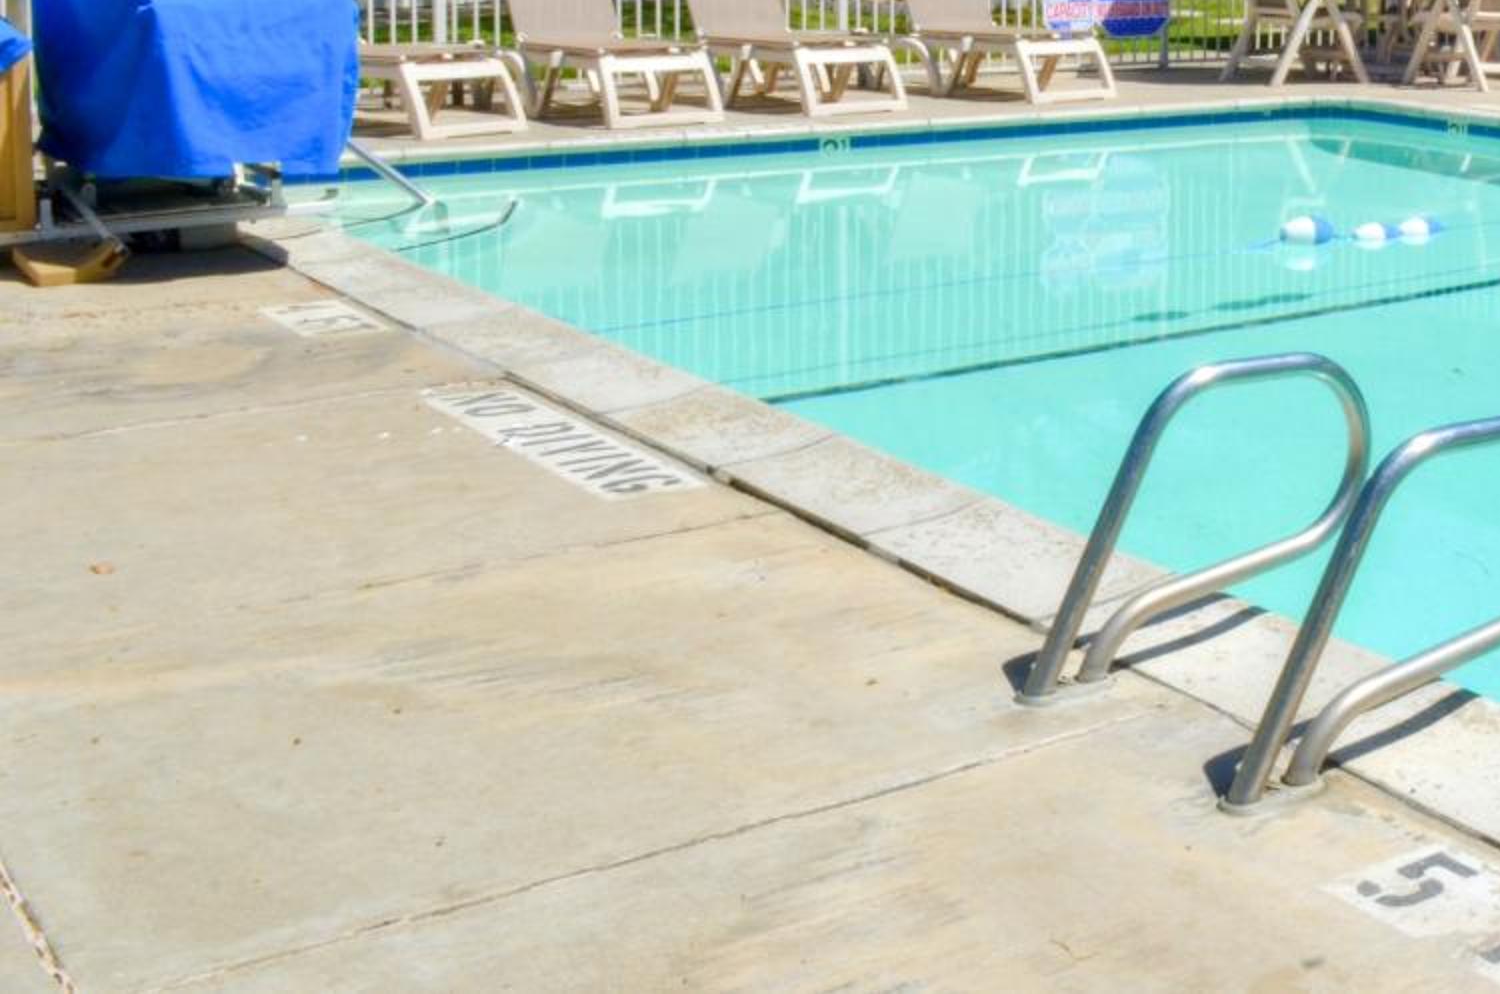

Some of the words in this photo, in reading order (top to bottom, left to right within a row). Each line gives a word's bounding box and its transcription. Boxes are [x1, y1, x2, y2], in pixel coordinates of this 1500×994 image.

[432, 391, 537, 417] NO
[498, 421, 682, 494] DIVING
[1356, 851, 1479, 907] 5
